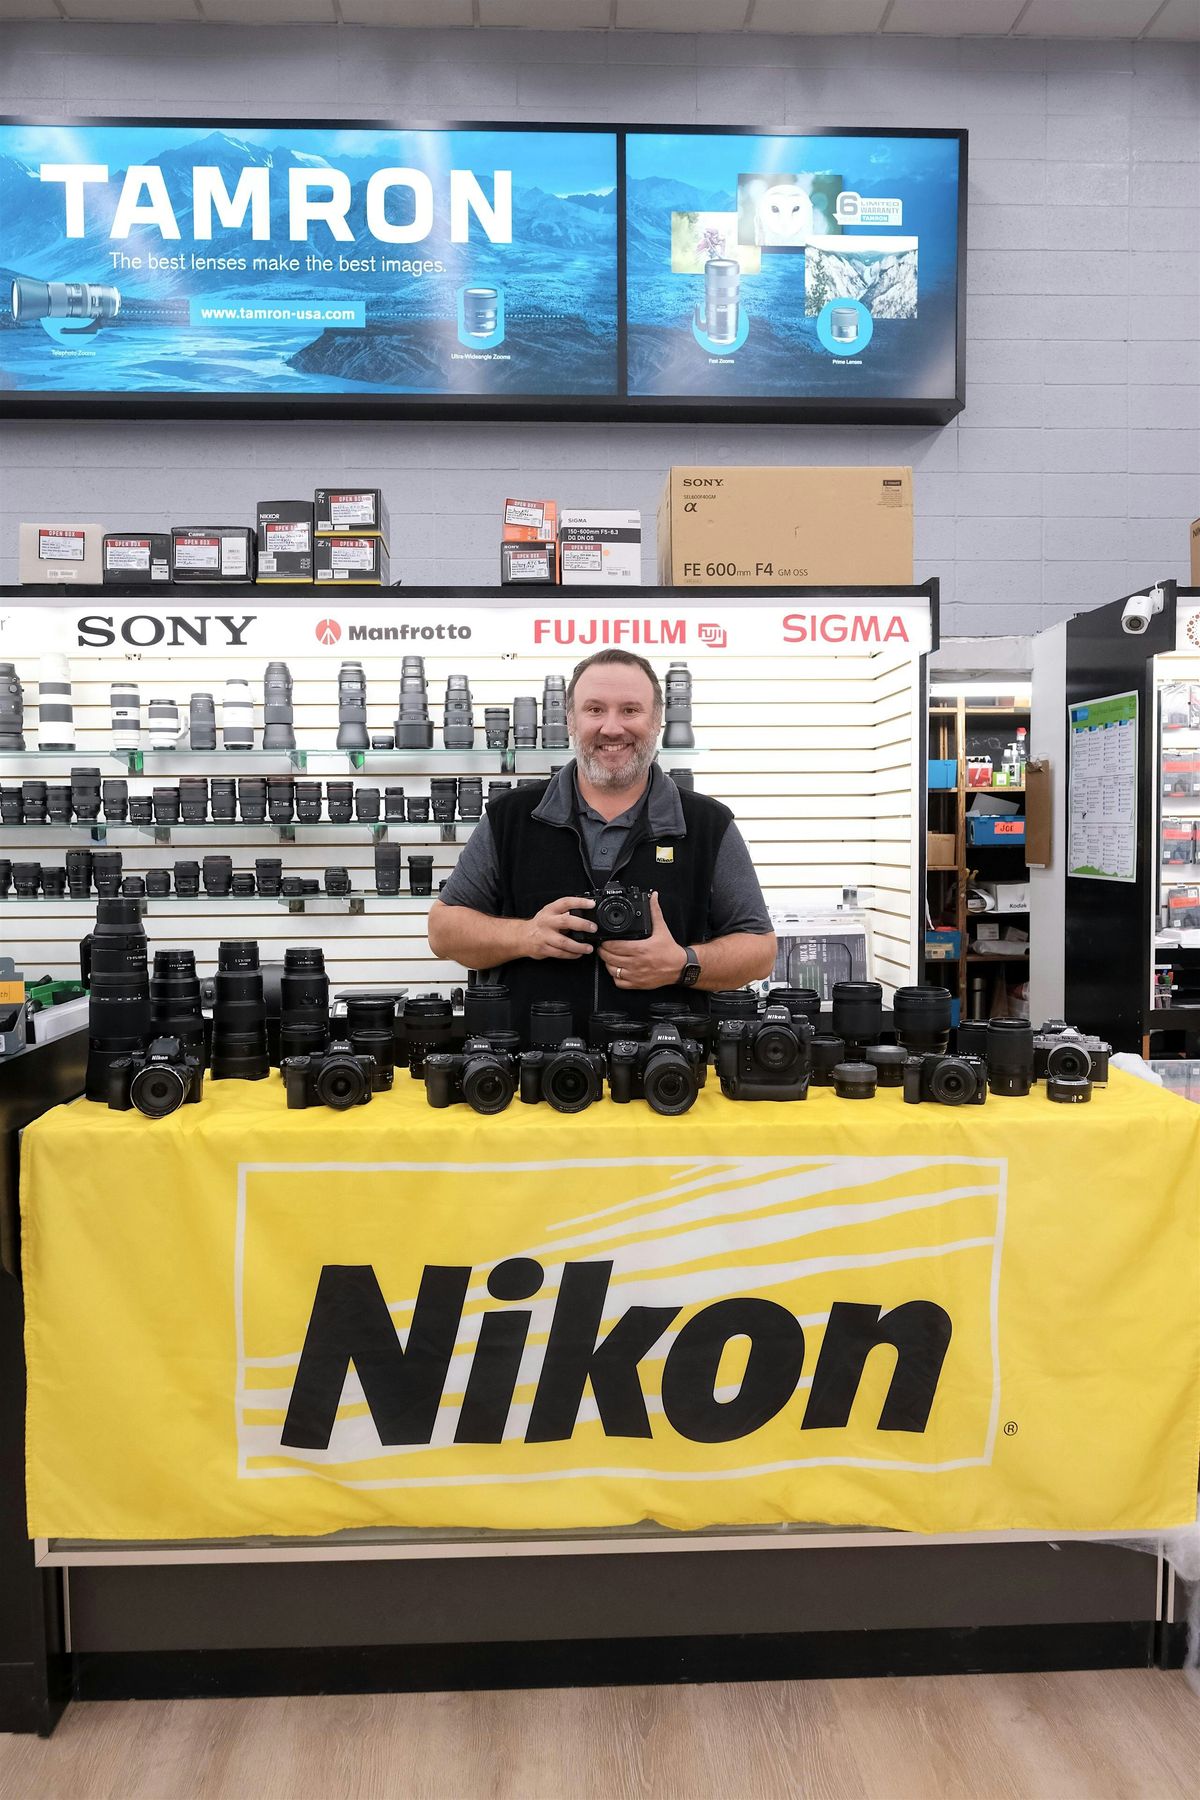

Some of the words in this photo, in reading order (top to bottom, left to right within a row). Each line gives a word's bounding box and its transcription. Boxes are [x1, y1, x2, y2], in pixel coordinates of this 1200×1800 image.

[40, 163, 513, 245] TAMRON
[840, 195, 858, 215] 6
[109, 252, 144, 270] The
[147, 252, 186, 271] best
[190, 253, 247, 271] lenses
[252, 254, 300, 272] make
[305, 254, 334, 272] the
[338, 255, 377, 273] best
[381, 256, 447, 277] images.
[201, 307, 355, 321] www.tamron-usa.com
[683, 479, 723, 487] SONY
[684, 563, 701, 576] FE
[706, 562, 751, 576] 600mm
[755, 562, 773, 576] F4
[778, 568, 791, 576] GM
[793, 568, 809, 576] OSS
[77, 615, 257, 647] SONY
[349, 624, 471, 641] Manfrotto
[534, 619, 686, 645] FUJIFILM
[782, 614, 910, 643] SIGMA
[280, 1257, 953, 1450] Nikon
